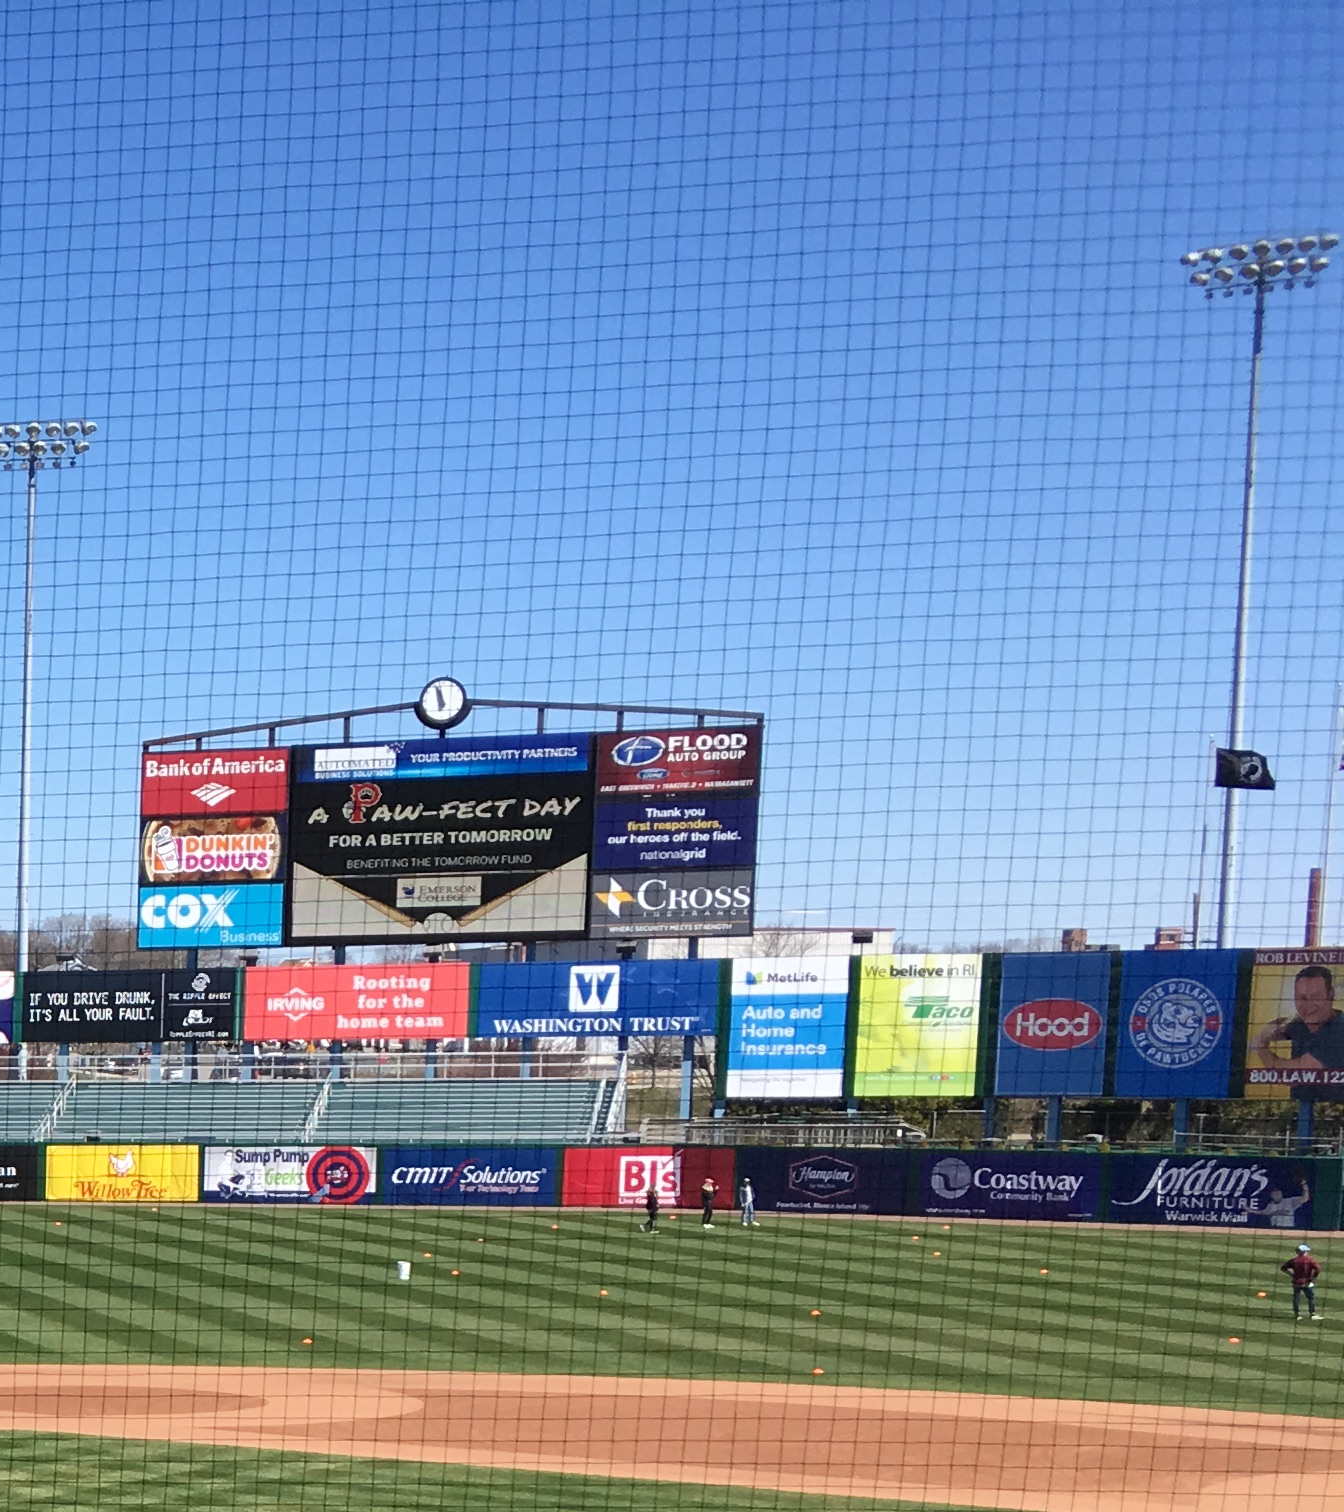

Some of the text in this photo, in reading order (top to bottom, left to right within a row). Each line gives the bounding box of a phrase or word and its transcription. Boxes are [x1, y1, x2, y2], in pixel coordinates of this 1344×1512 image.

[668, 733, 748, 751] FLOOD
[411, 753, 439, 764] YOUR
[667, 750, 746, 762] AUTO GROUP
[146, 756, 285, 777] Bank of America
[308, 796, 581, 824] A DAY
[646, 808, 706, 819] Thank you
[627, 821, 651, 831] first
[186, 834, 274, 853] DUNKIN'
[329, 828, 553, 847] FOR A BETTER TOMORROW
[608, 832, 710, 844] our heroes off the
[186, 853, 268, 870] DONUTS
[412, 854, 532, 867] THE FUND
[638, 879, 750, 910] CROSS
[141, 890, 239, 933] COX
[220, 930, 279, 943] Business
[1256, 952, 1338, 963] ROB LEVINE
[767, 972, 817, 983] MetLife
[865, 965, 958, 977] We believe in
[353, 976, 431, 992] Rooting
[30, 991, 154, 1006] IF YOU DRIVE DRUNK,
[267, 996, 325, 1011] IRVING
[358, 995, 425, 1008] for the
[30, 1006, 154, 1022] IT'S ALL YOUR FAULT.
[742, 1005, 822, 1020] Auto and
[337, 1015, 443, 1029] home team
[493, 1017, 694, 1033] WASHINGTON TRUST
[1015, 1012, 1089, 1037] Hood
[741, 1024, 795, 1038] Home
[741, 1042, 826, 1055] Insurance
[235, 1149, 309, 1166] Sump Pump
[265, 1168, 304, 1186] Geeks
[460, 1166, 541, 1184] Solutions
[793, 1166, 854, 1182] Hampton
[74, 1180, 168, 1199] Willow Tree
[974, 1168, 1083, 1198] Coastway
[1111, 1158, 1268, 1206] Jordan's
[1046, 1192, 1069, 1201] Bank
[1157, 1196, 1259, 1210] FURNITURE
[1165, 1210, 1248, 1223] Warwick Mall
